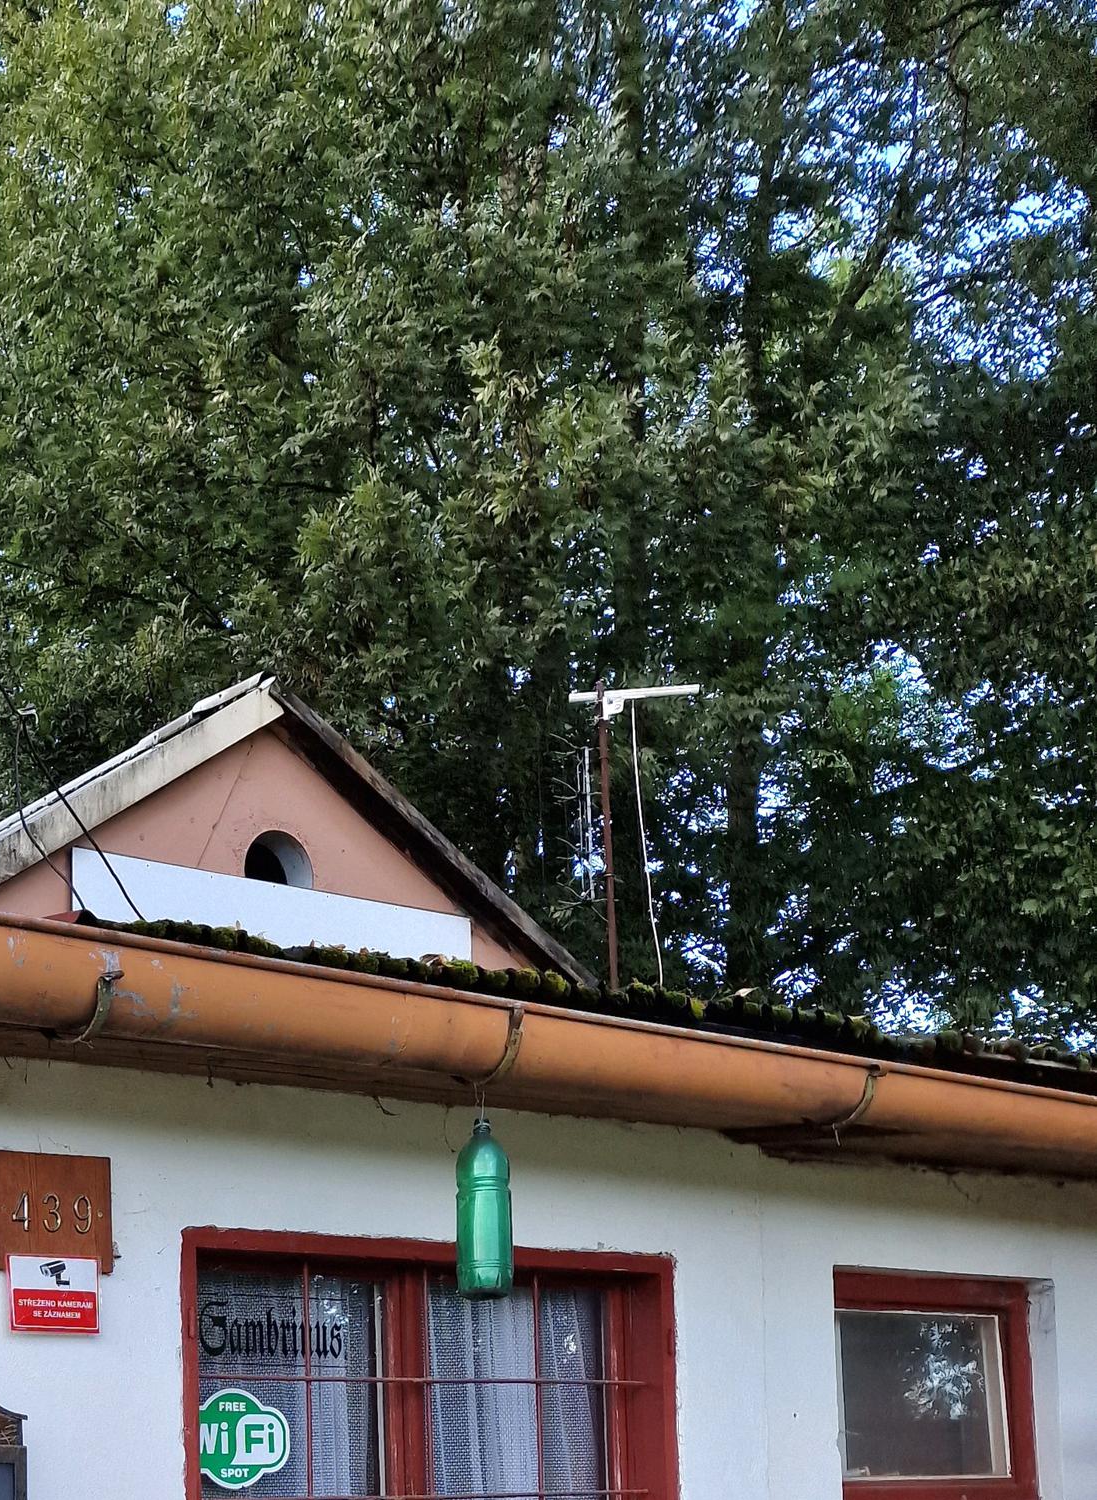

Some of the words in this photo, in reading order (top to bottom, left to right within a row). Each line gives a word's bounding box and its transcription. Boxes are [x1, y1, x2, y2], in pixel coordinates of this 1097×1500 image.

[11, 1191, 94, 1234] 439
[18, 1298, 56, 1308] STŘEŽENO
[57, 1300, 94, 1310] KAMERAMI
[32, 1310, 43, 1318] SE
[43, 1309, 82, 1319] ZÁZNAMEM
[201, 1300, 344, 1361] Gambrinus
[218, 1401, 247, 1412] FREE
[220, 1467, 250, 1478] SPOT
